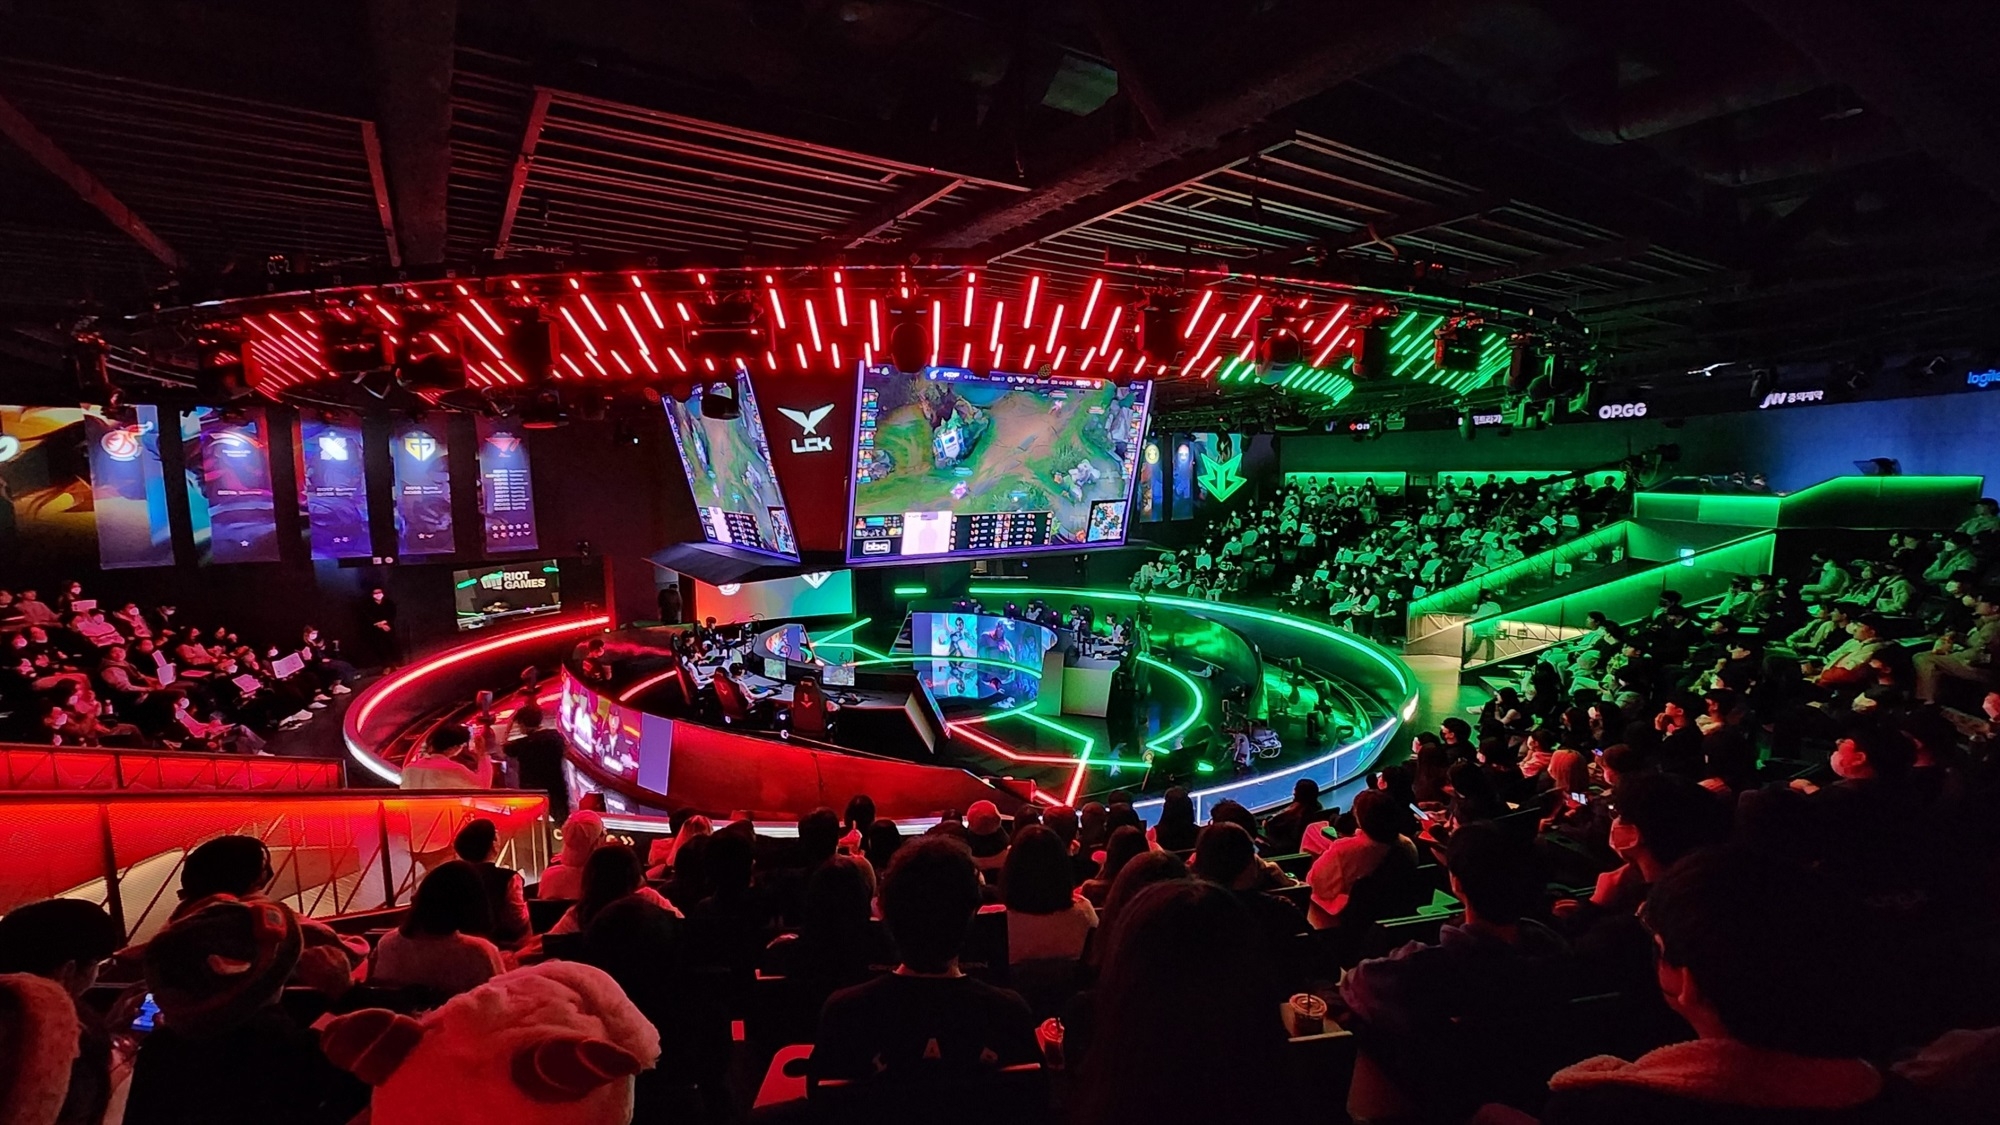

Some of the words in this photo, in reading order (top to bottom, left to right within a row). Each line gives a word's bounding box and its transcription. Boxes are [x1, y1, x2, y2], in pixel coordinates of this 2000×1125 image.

[1598, 402, 1647, 419] OP.GG
[791, 436, 833, 453] LCK
[503, 571, 530, 580] RIOT
[503, 578, 546, 590] GAMES
